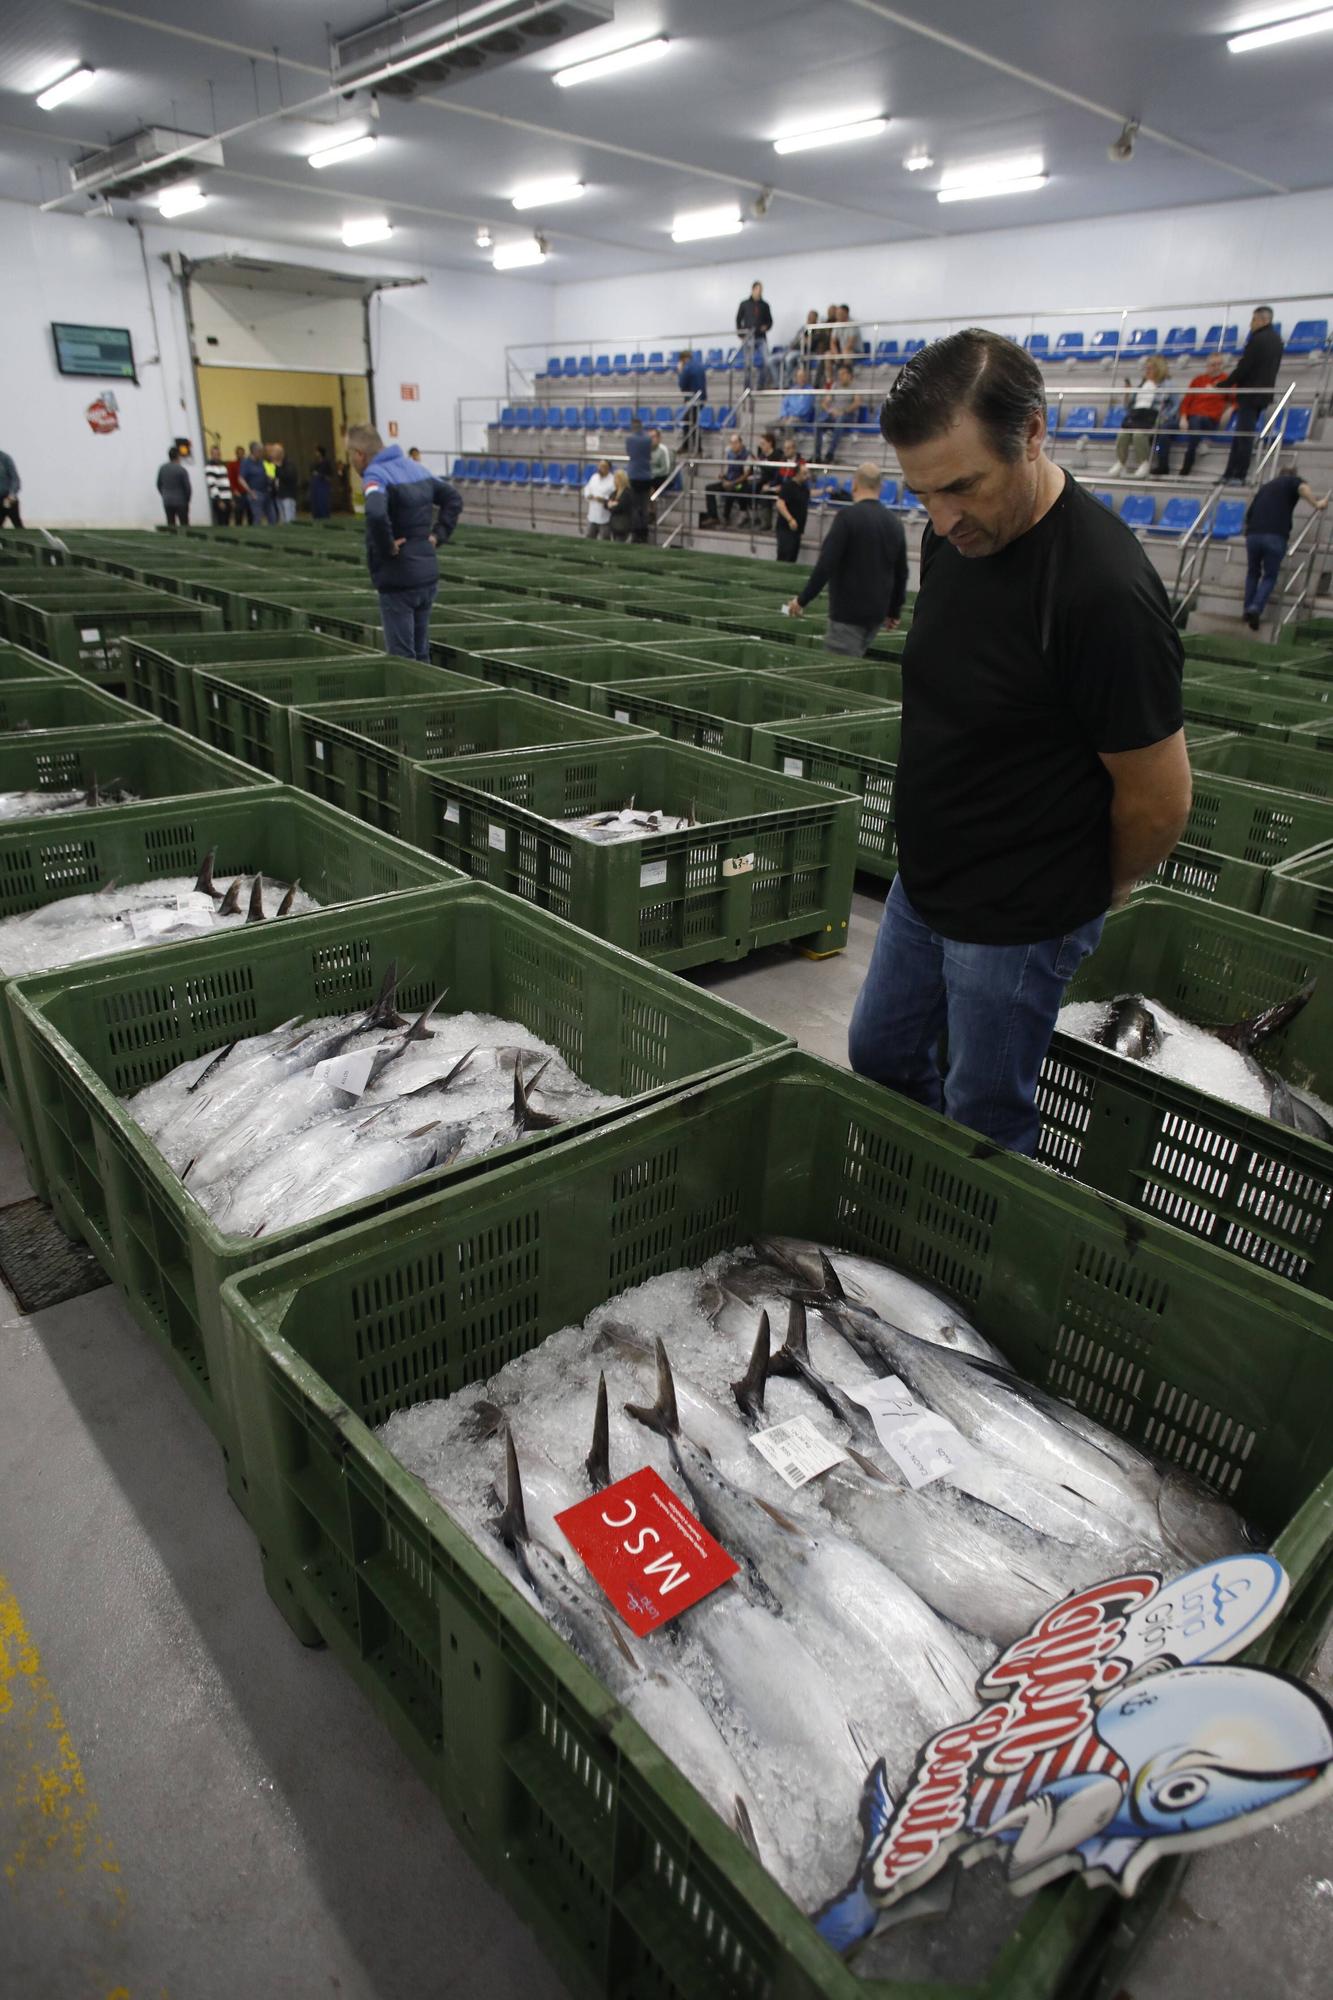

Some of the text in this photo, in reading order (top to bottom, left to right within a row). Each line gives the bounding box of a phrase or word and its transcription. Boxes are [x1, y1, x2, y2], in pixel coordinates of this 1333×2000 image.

[1139, 1602, 1174, 1657] Gijón
[1178, 1582, 1213, 1637] Lonja
[987, 1576, 1157, 1770] Gijón
[878, 1703, 1011, 1883] Bonito
